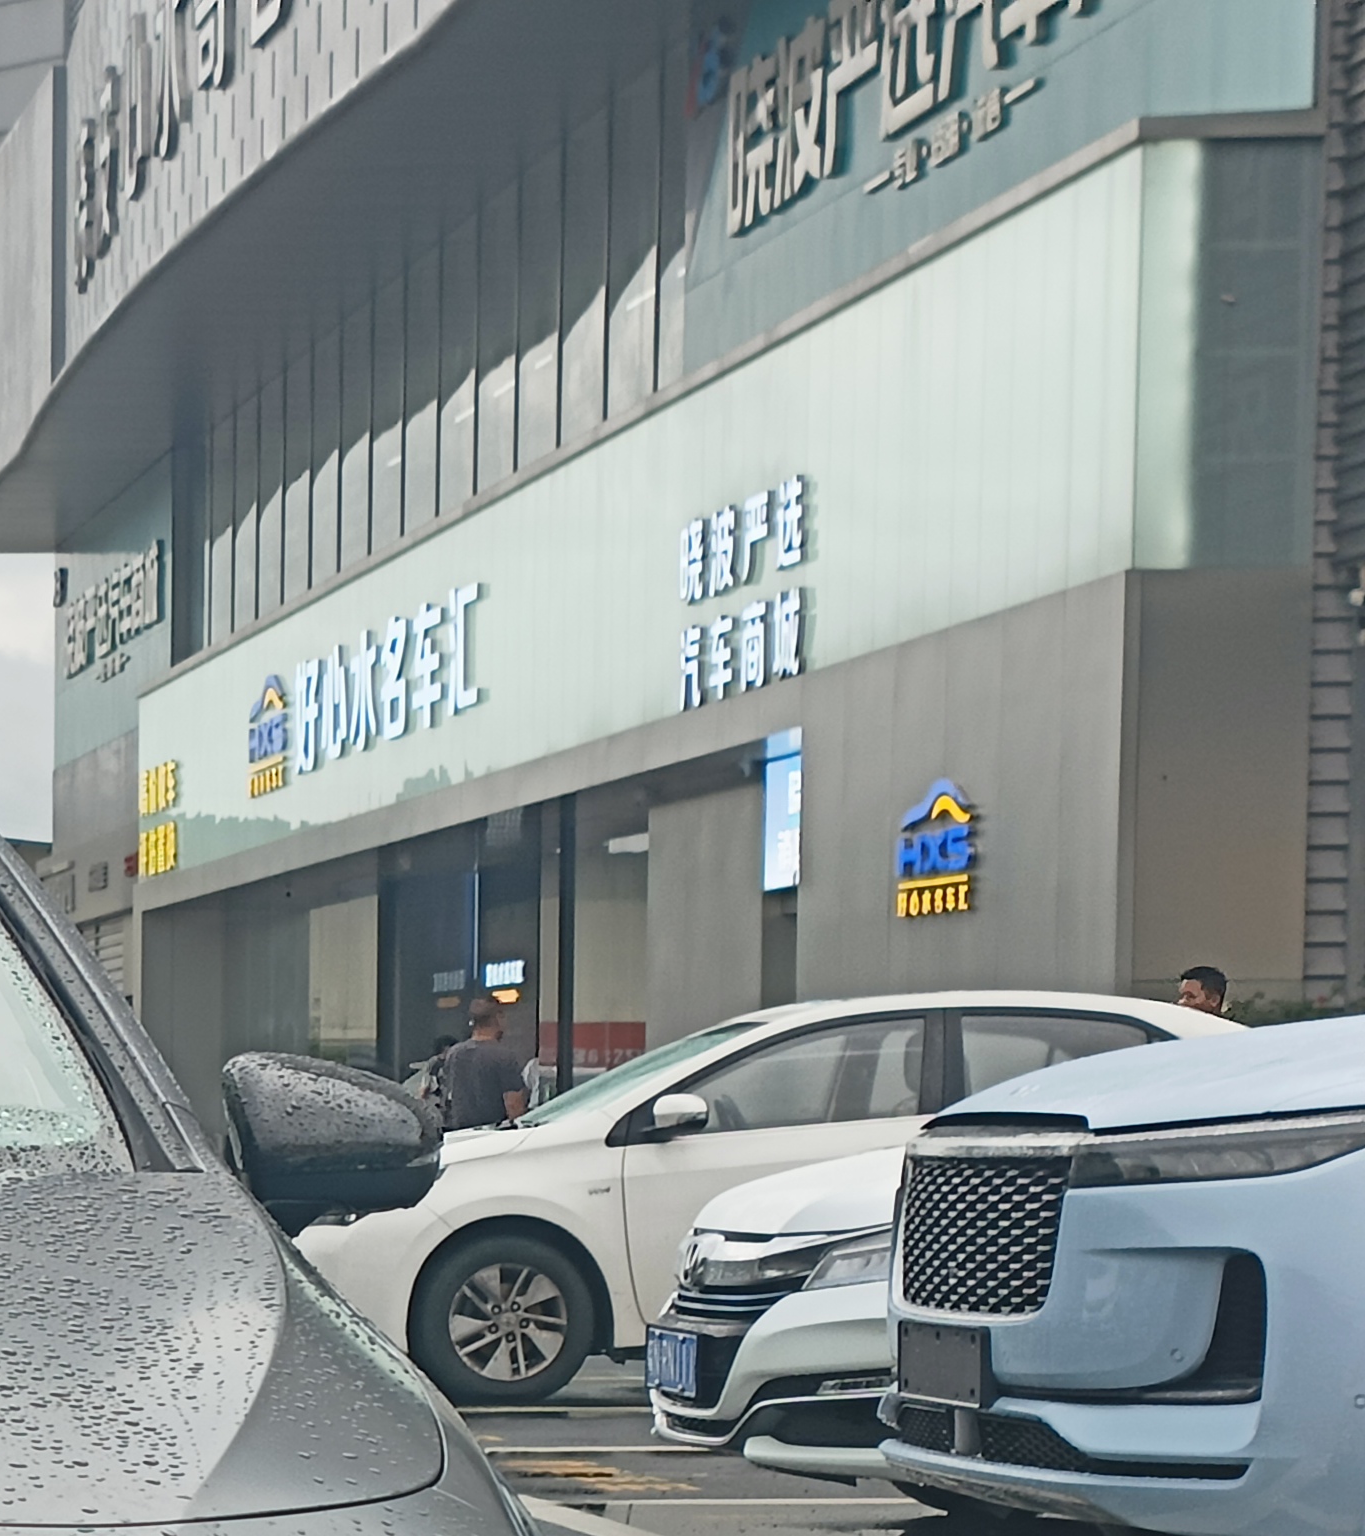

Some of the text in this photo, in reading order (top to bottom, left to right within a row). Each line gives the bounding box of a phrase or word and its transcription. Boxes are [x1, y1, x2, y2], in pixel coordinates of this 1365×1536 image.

[680, 475, 804, 605] 晓波严选
[295, 582, 479, 776] 好心水名车汇
[680, 587, 802, 712] 汽车商城
